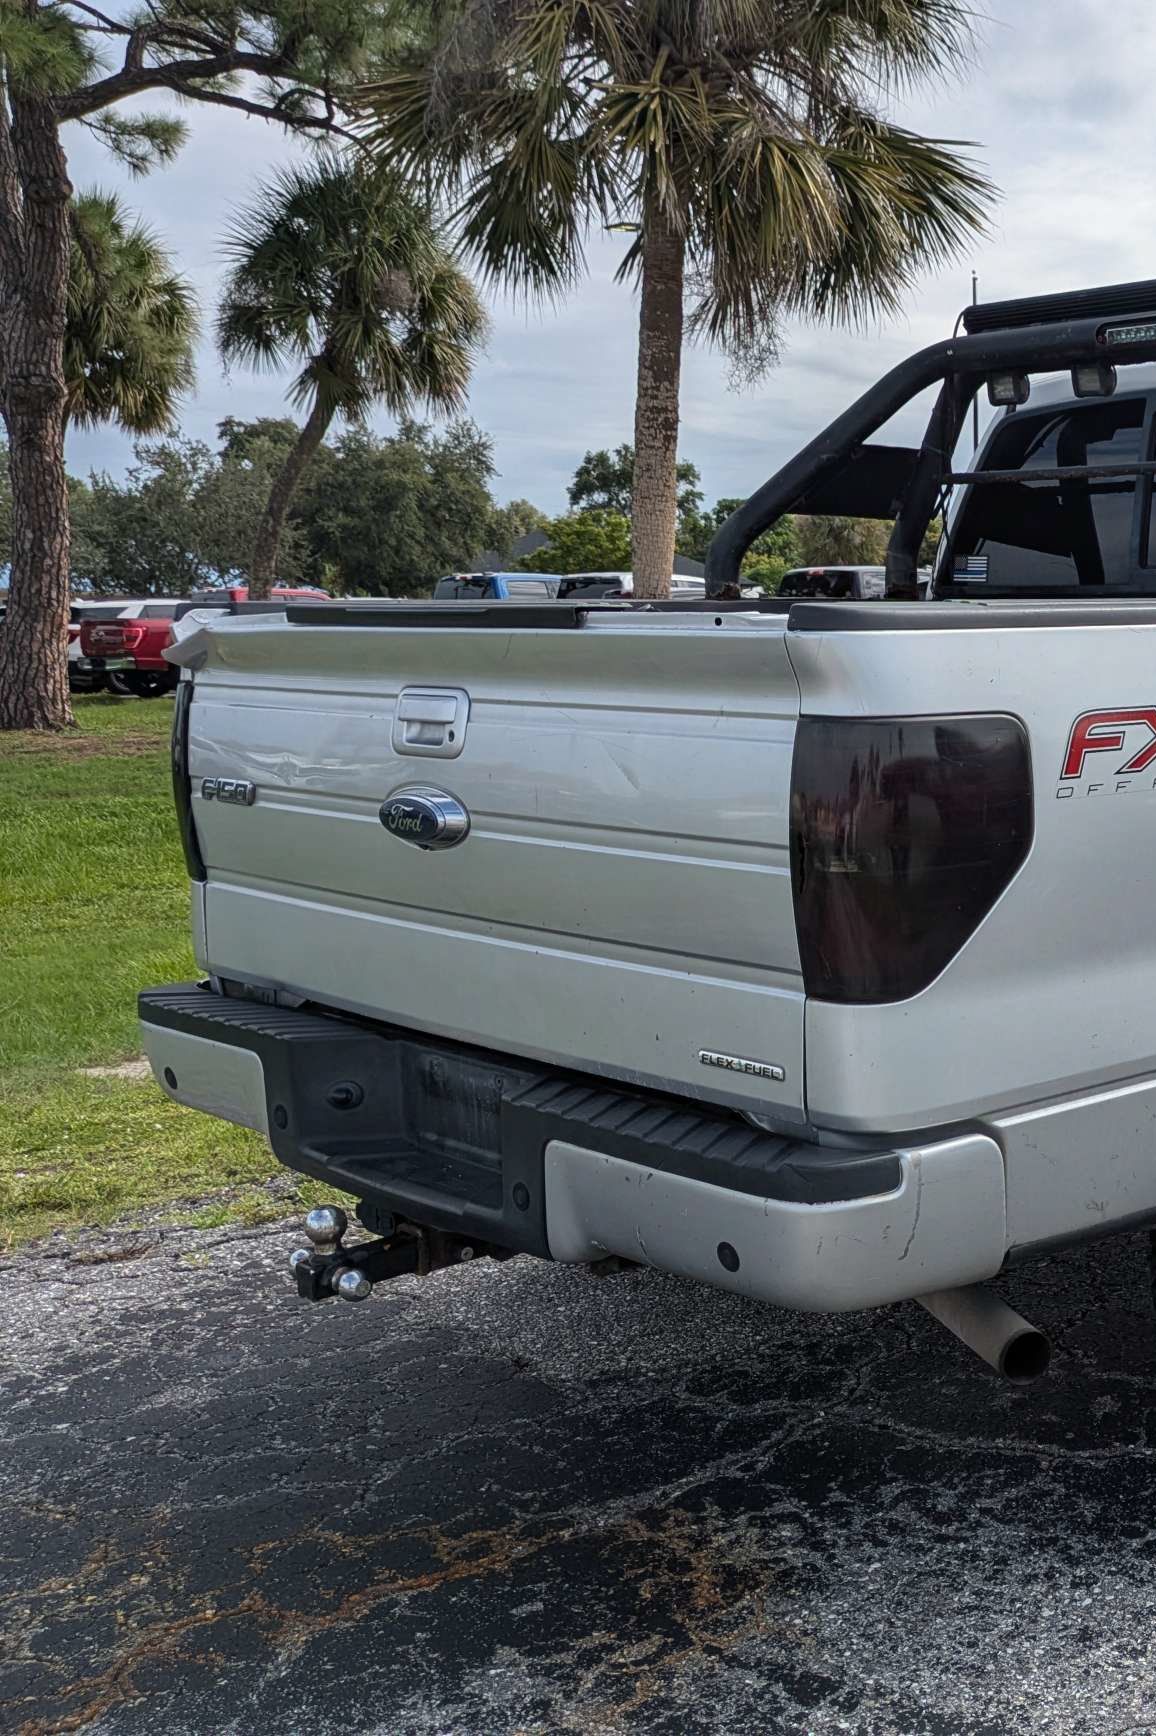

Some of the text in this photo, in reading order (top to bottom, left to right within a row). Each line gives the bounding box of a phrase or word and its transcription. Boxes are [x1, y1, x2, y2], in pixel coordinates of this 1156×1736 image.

[1056, 780, 1132, 799] OFF
[388, 803, 423, 833] Ford
[701, 1053, 781, 1081] FLEX FUEL
